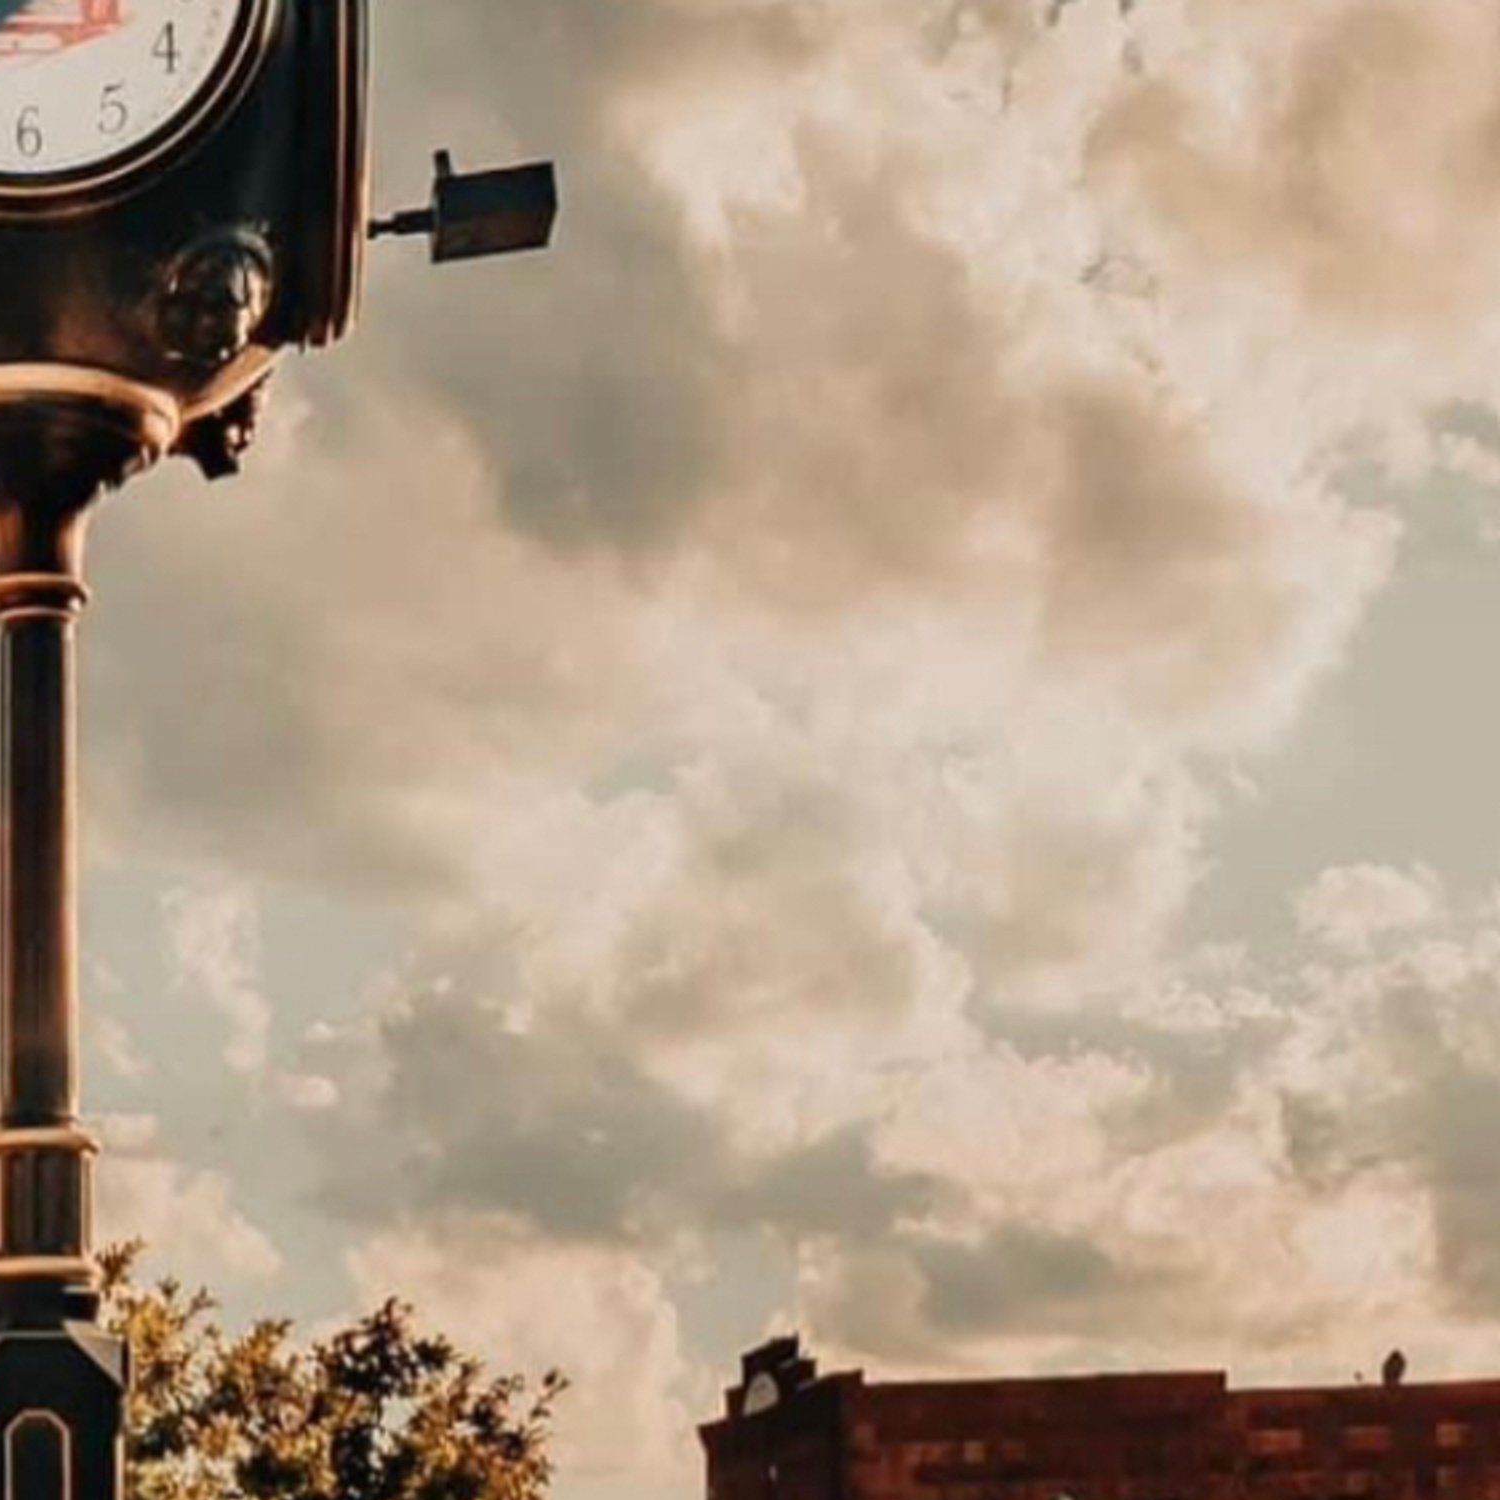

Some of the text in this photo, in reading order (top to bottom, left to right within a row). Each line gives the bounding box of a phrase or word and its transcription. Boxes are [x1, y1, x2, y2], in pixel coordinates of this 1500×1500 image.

[152, 22, 180, 75] 4
[16, 106, 41, 158] 6
[100, 84, 127, 134] 5
